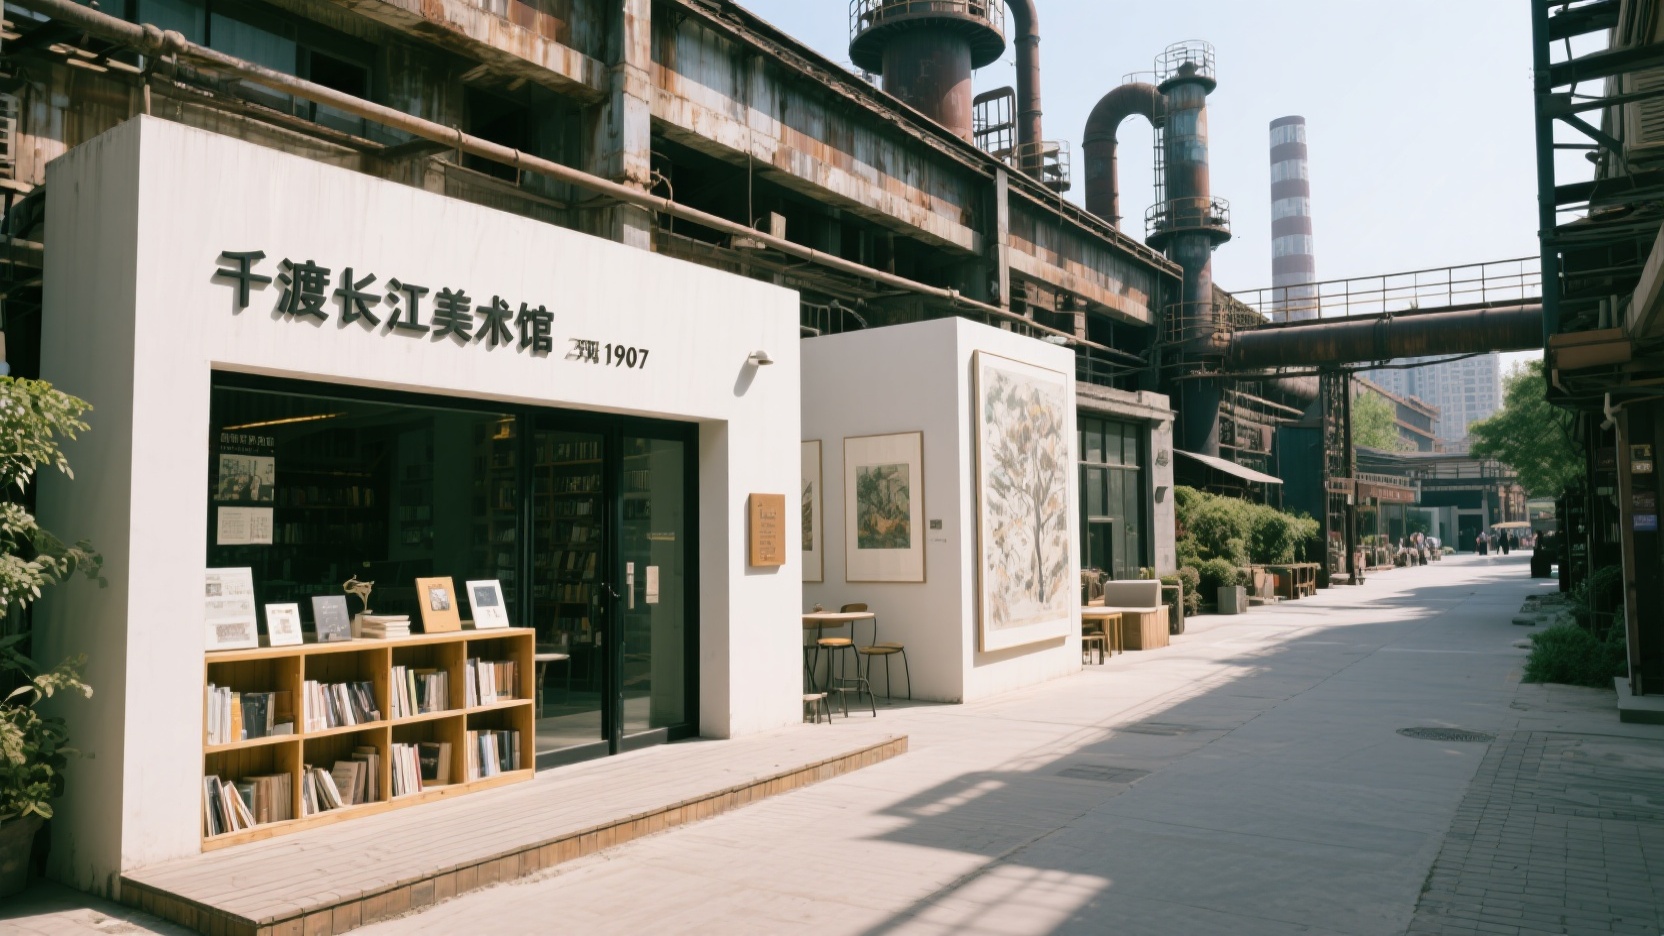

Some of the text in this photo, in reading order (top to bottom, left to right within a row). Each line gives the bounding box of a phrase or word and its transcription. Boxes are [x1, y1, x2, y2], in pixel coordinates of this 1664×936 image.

[216, 249, 555, 353] 千渡长江美术馆
[605, 343, 649, 369] 1907
